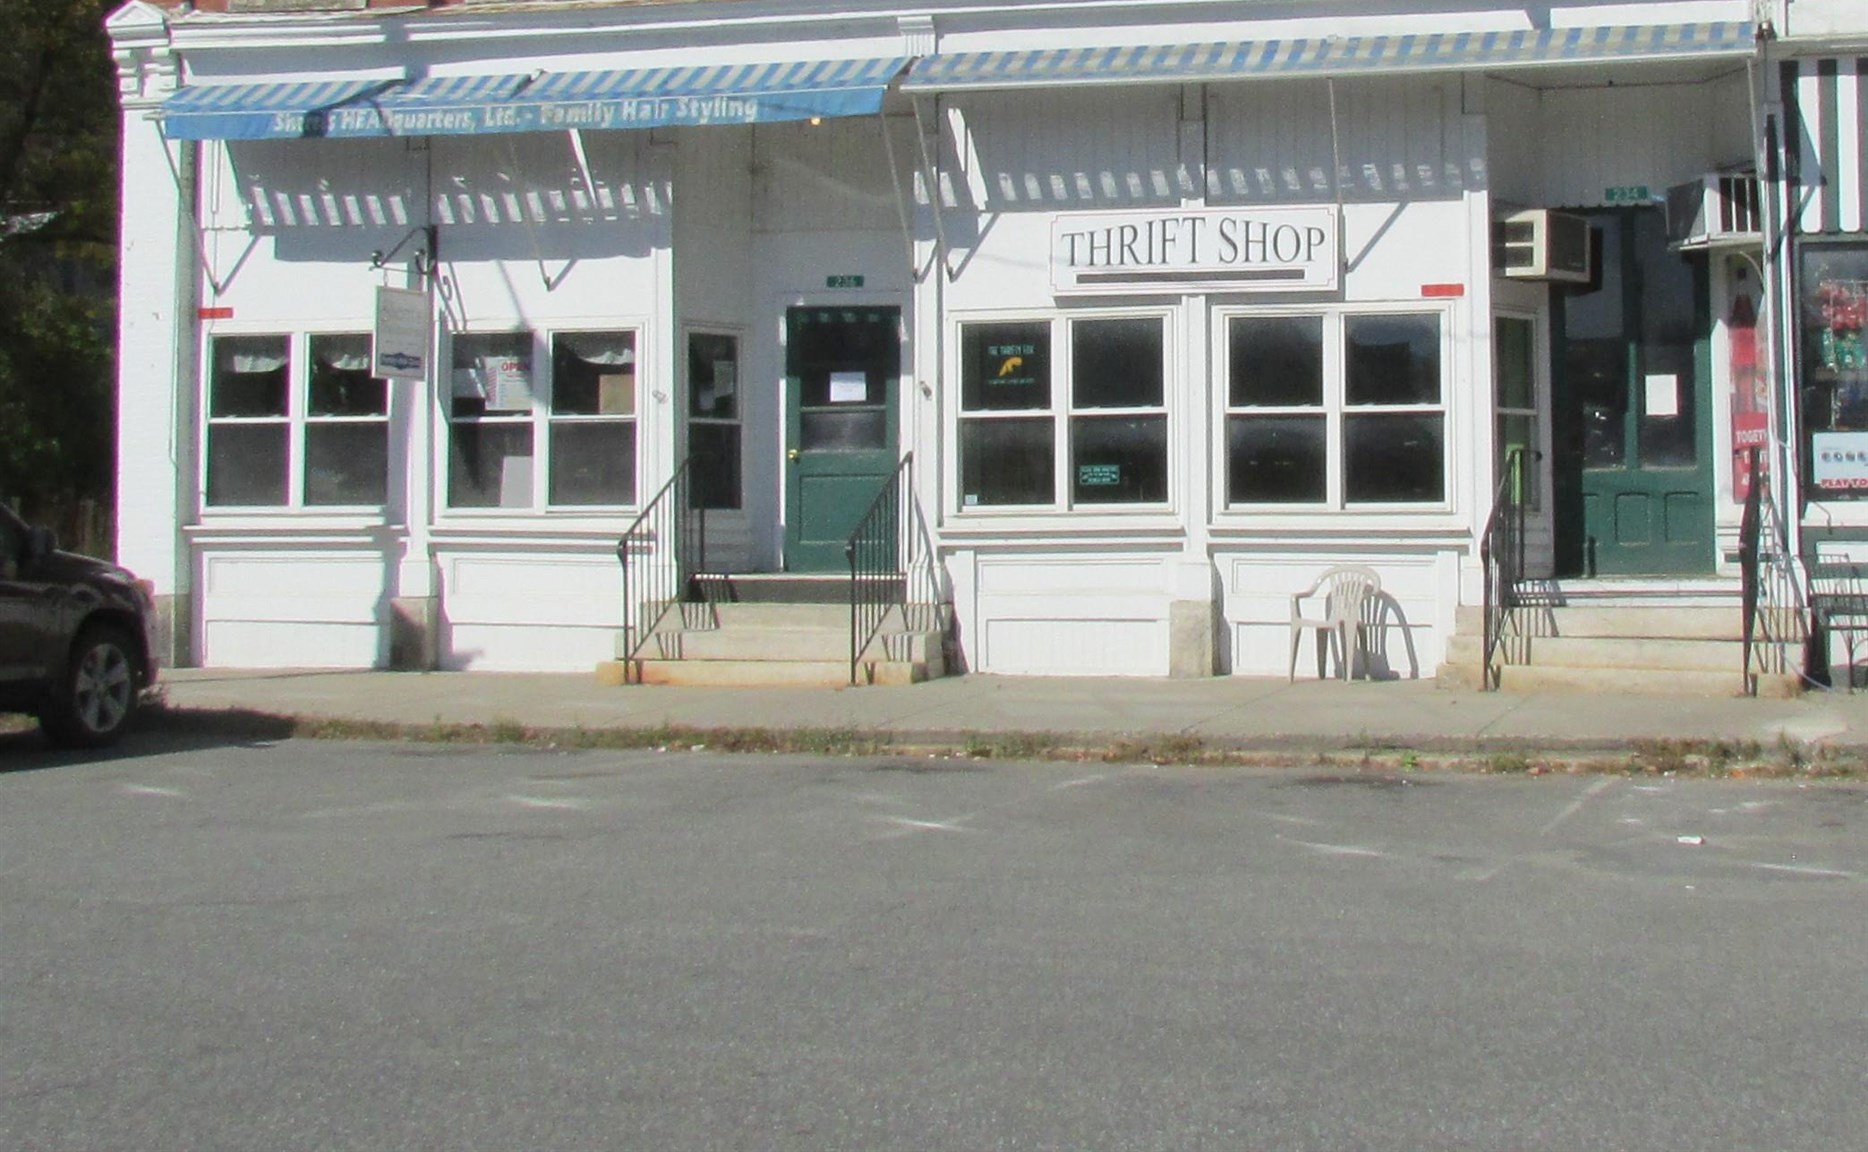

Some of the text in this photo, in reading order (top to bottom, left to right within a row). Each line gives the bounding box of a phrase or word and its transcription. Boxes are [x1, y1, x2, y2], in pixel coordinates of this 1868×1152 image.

[541, 102, 614, 128] Family
[622, 99, 670, 121] Hair
[676, 96, 758, 125] Styling
[1062, 217, 1326, 266] THRIFT SHOP
